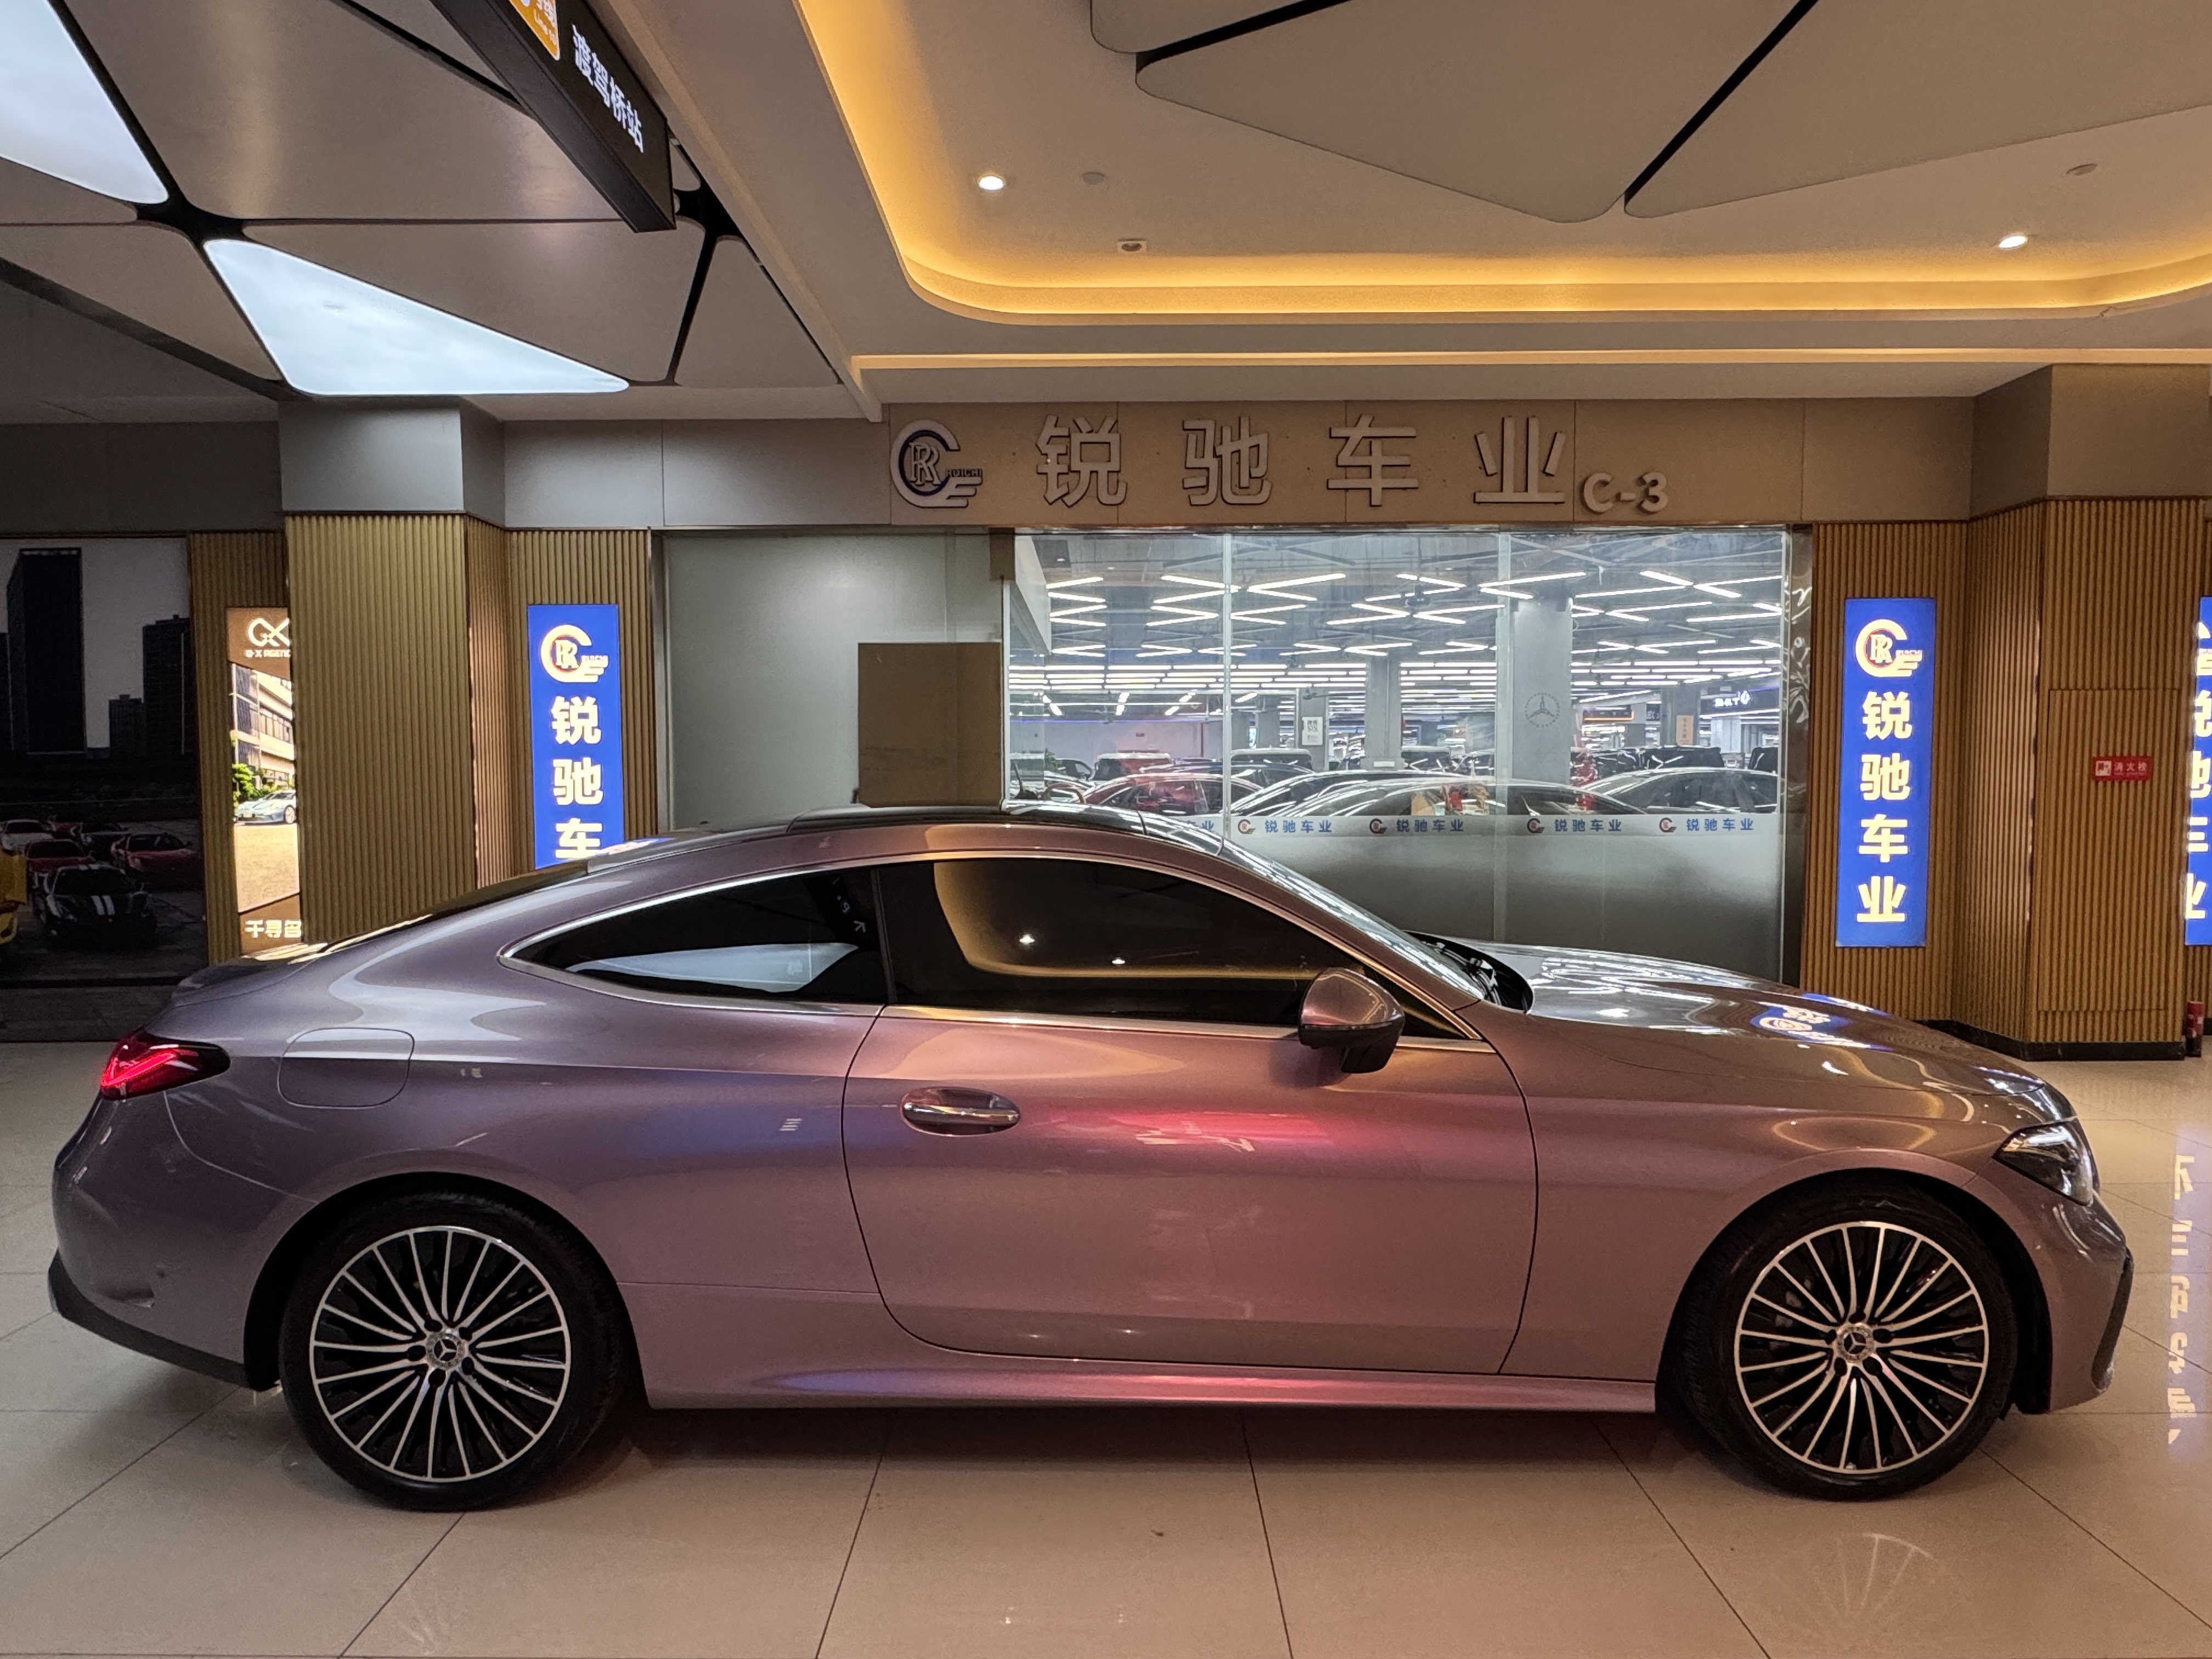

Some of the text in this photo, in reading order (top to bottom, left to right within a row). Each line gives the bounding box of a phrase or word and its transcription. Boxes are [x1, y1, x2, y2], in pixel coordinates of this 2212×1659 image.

[572, 24, 644, 153] 渡驾桥站
[1035, 414, 1565, 507] 锐驰车业
[1581, 472, 1668, 514] C-3
[1857, 691, 1912, 923] 锐驰车业
[1264, 820, 1332, 833] 锐驰车业
[1396, 819, 1464, 833] 锐驰车业
[1554, 819, 1621, 832] 锐驰车业
[1686, 819, 1753, 832] 锐驰车业
